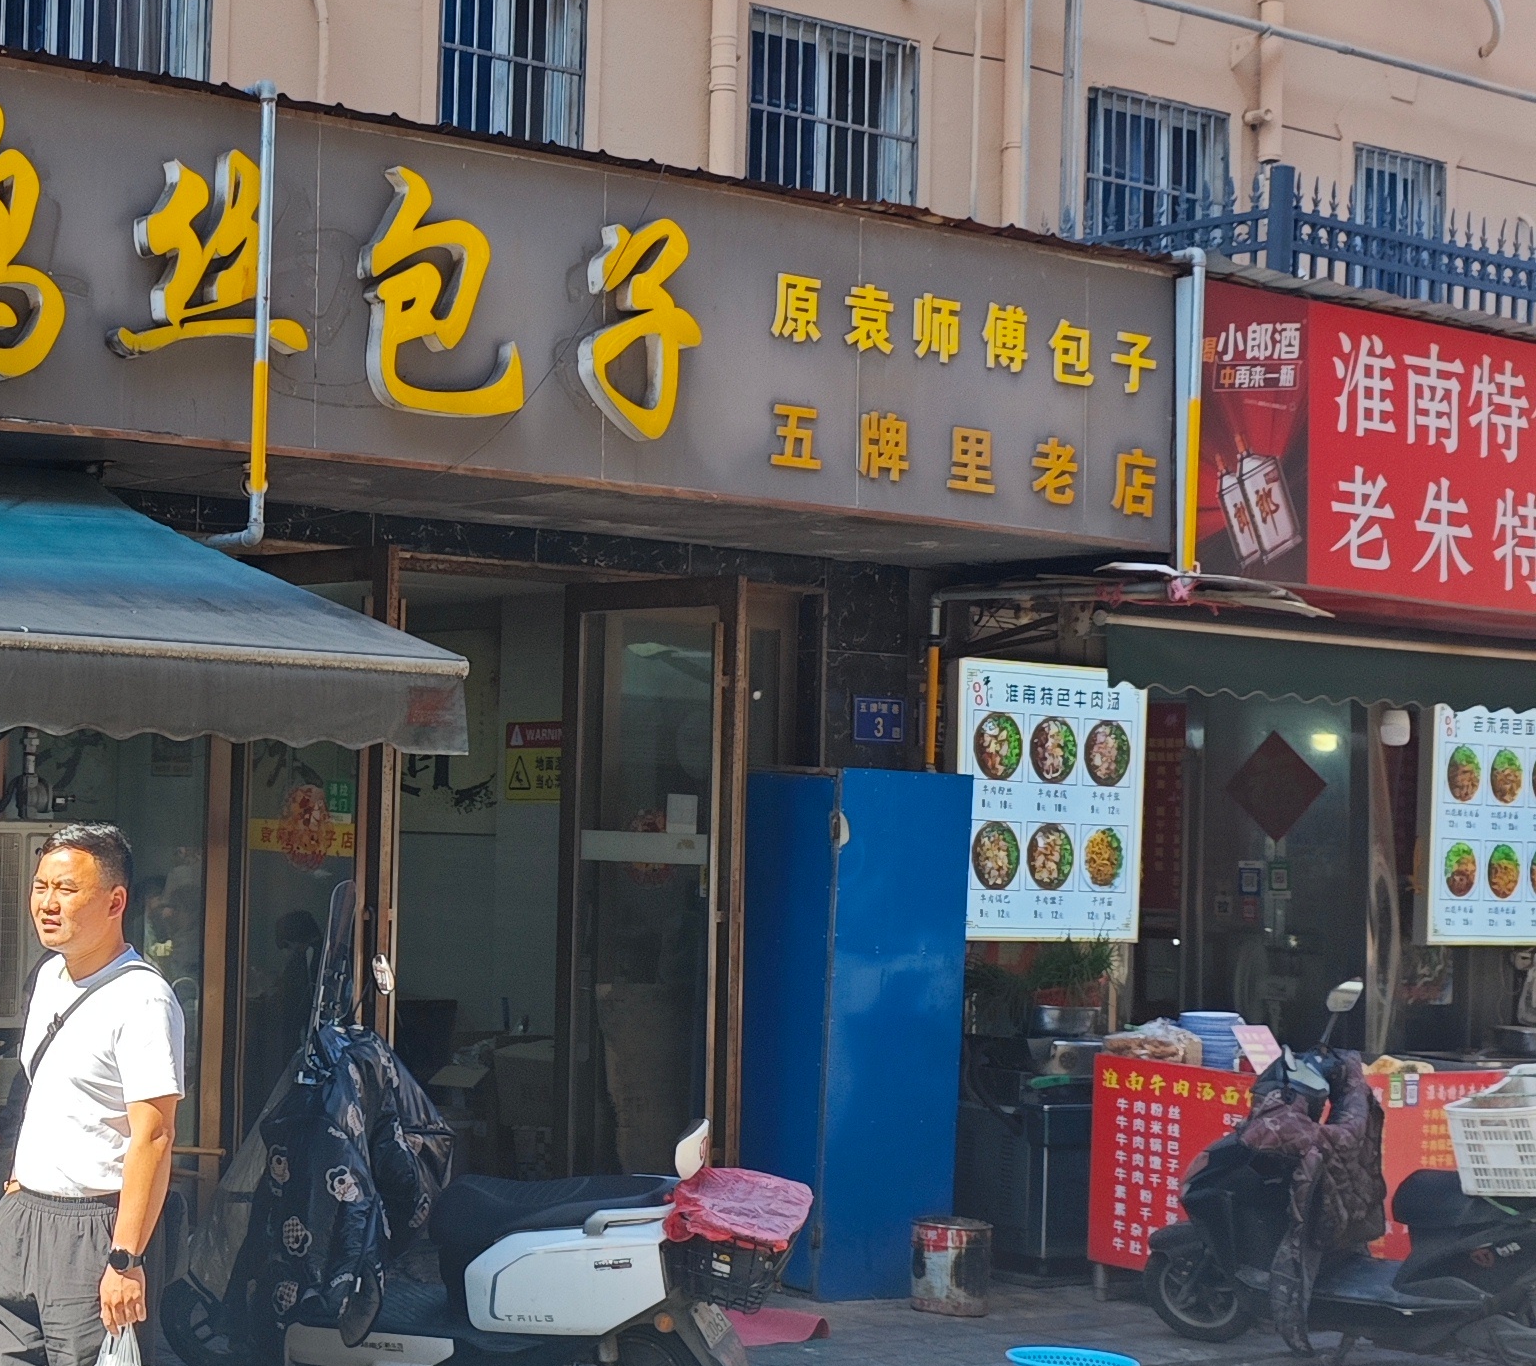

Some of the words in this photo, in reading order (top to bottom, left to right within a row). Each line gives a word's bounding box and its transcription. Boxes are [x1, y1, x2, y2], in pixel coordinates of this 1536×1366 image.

[770, 272, 1157, 394] 原袁师傅包子
[1217, 322, 1302, 361] 小郎酒
[1332, 331, 1536, 463] 淮南特
[770, 403, 1157, 518] 五牌里老店
[1329, 464, 1536, 595] 老朱特
[1005, 682, 1121, 711] 淮南特色牛肉汤
[874, 717, 884, 737] 3
[1116, 1097, 1181, 1120] 牛肉粉丝
[1115, 1115, 1181, 1138] 牛肉米线
[1115, 1132, 1180, 1155] 牛肉锅巴
[1114, 1167, 1180, 1191] 牛肉千张
[1112, 1237, 1152, 1256] 牛肚
